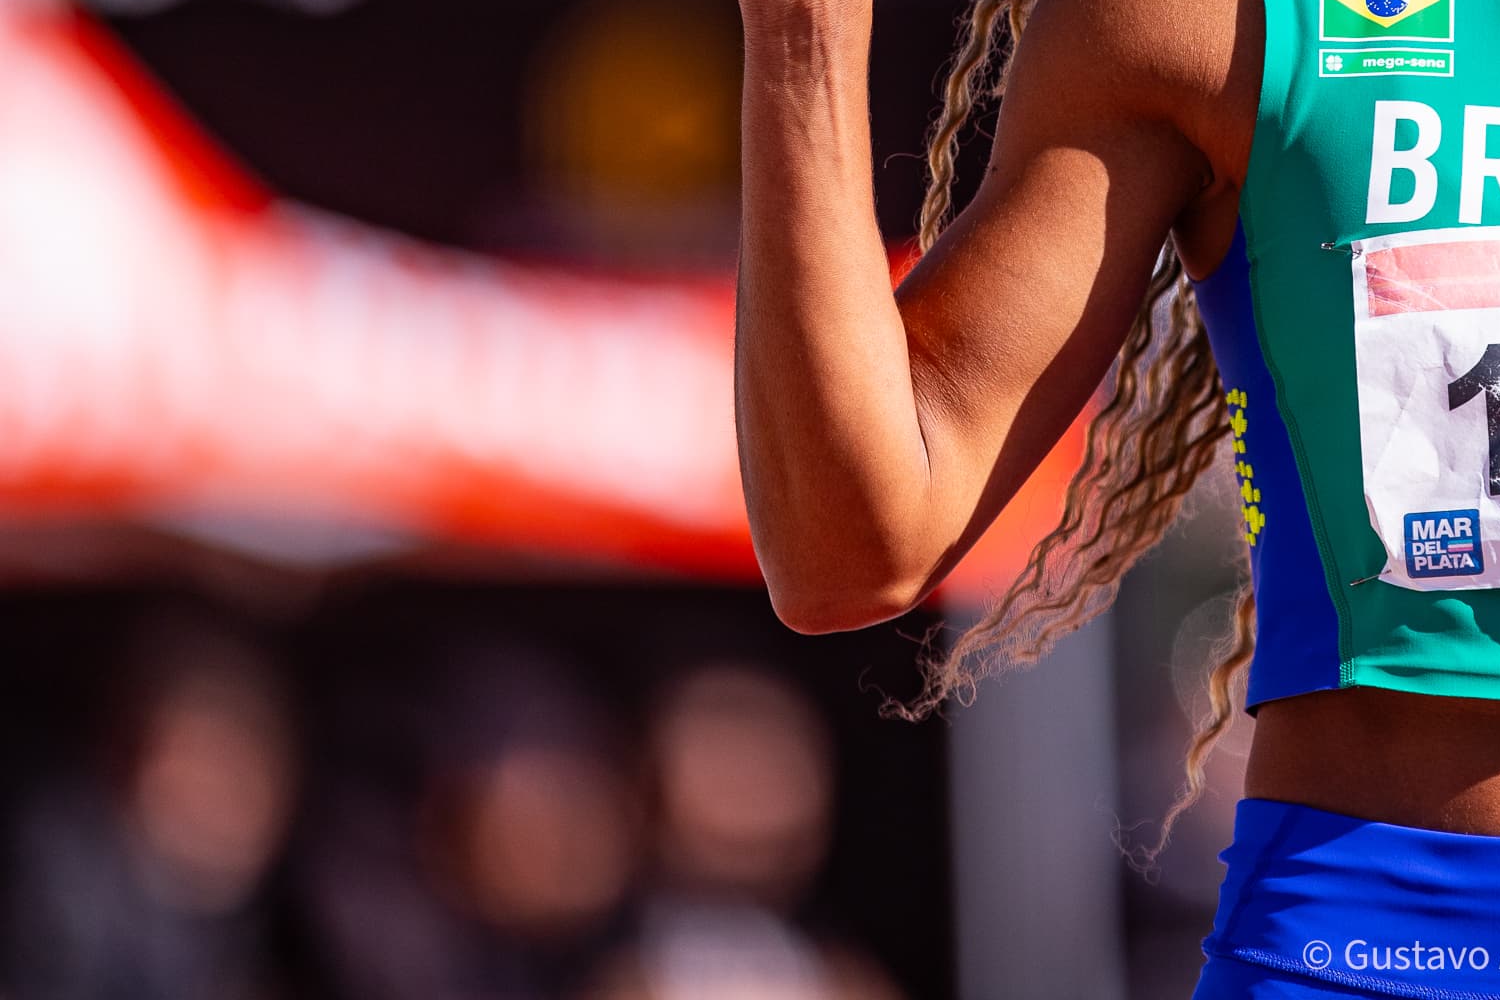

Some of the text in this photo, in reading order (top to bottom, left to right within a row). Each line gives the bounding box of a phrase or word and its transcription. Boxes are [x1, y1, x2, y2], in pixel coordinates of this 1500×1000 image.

[1363, 57, 1446, 69] mega-sena
[1412, 517, 1473, 540] MAR
[1412, 540, 1447, 556] DEL
[1414, 553, 1475, 571] PLATA
